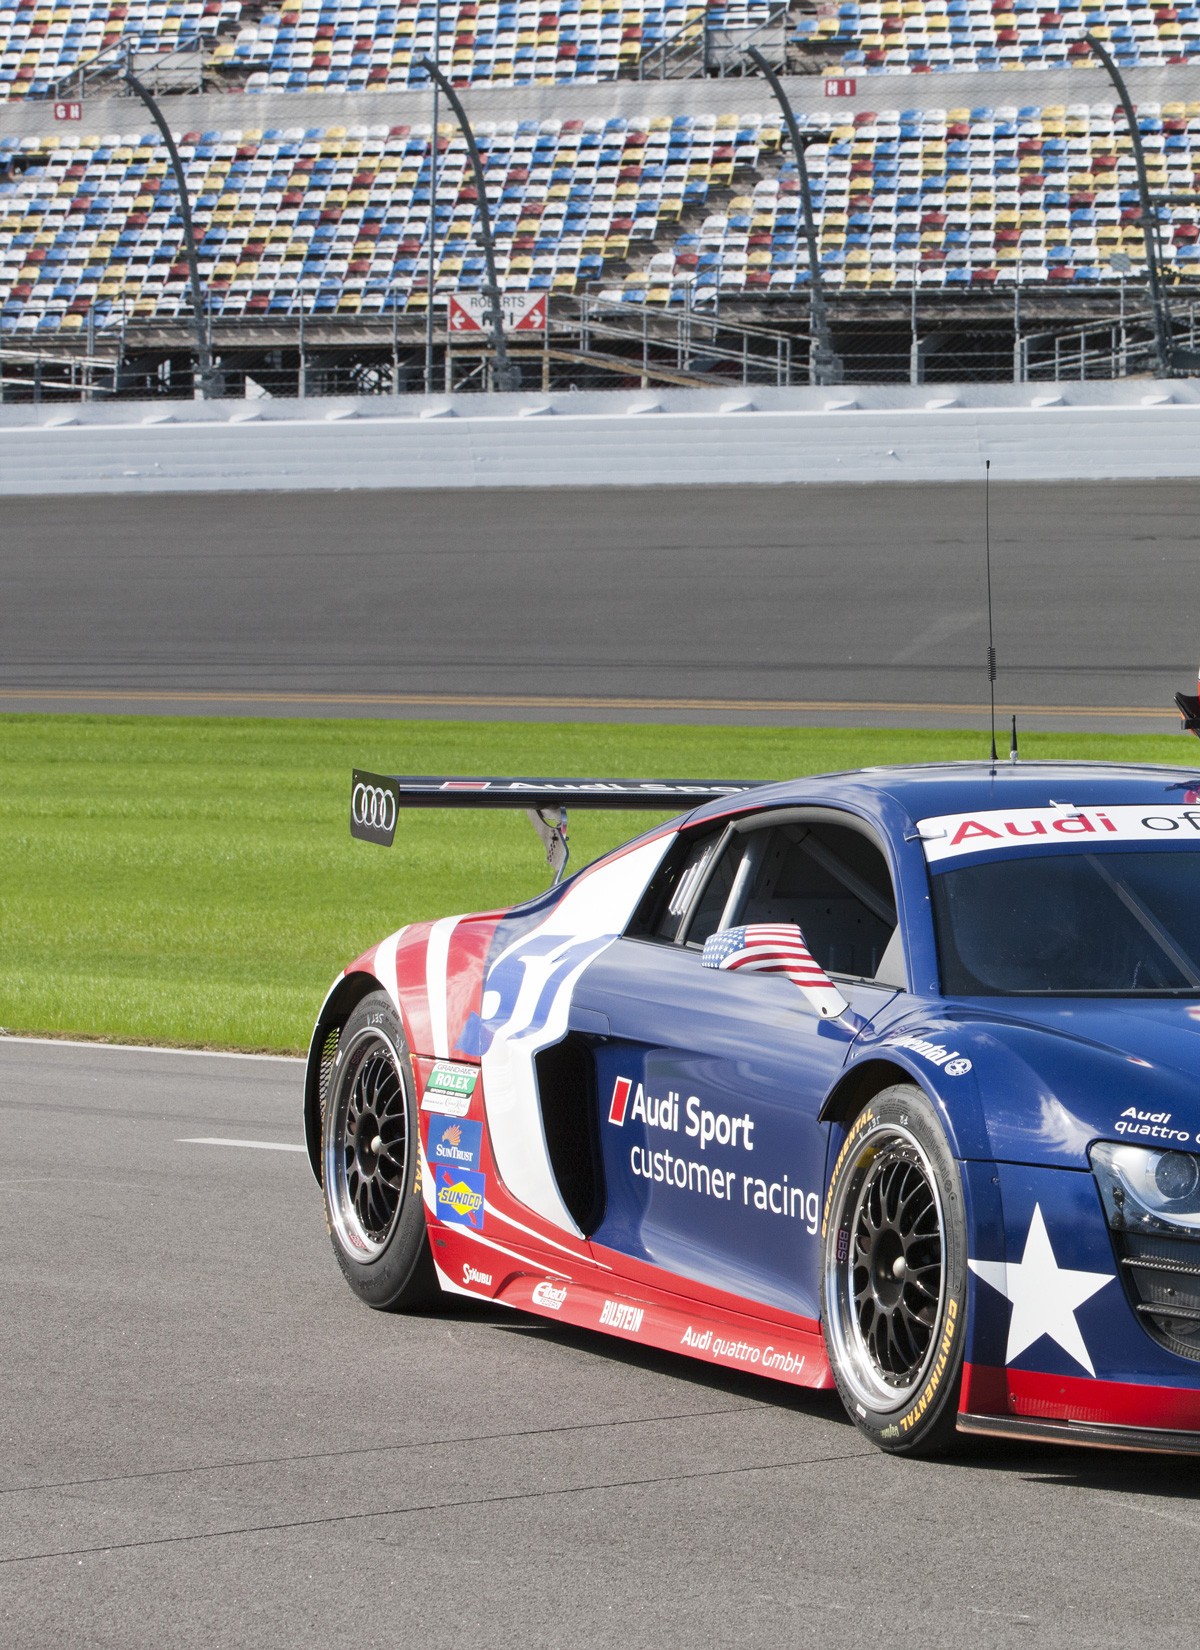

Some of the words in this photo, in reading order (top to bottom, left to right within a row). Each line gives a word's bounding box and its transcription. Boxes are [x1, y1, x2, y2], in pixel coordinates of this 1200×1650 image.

[471, 296, 526, 308] ROBRTS
[508, 781, 630, 791] Audi
[948, 812, 1119, 846] Audi
[435, 1073, 470, 1091] ROLEX
[630, 1082, 681, 1133] Audi
[684, 1096, 755, 1151] Sport
[1120, 1105, 1173, 1125] Audi
[1113, 1120, 1191, 1143] quattro
[440, 1189, 481, 1209] SUNOCO
[630, 1145, 736, 1202] customer
[742, 1174, 820, 1236] racing
[599, 1299, 645, 1333] BILSTEIN
[681, 1325, 713, 1351] Audi
[712, 1338, 761, 1364] quattro
[761, 1345, 805, 1375] GmbH
[899, 1298, 959, 1432] CONTINENTAL
